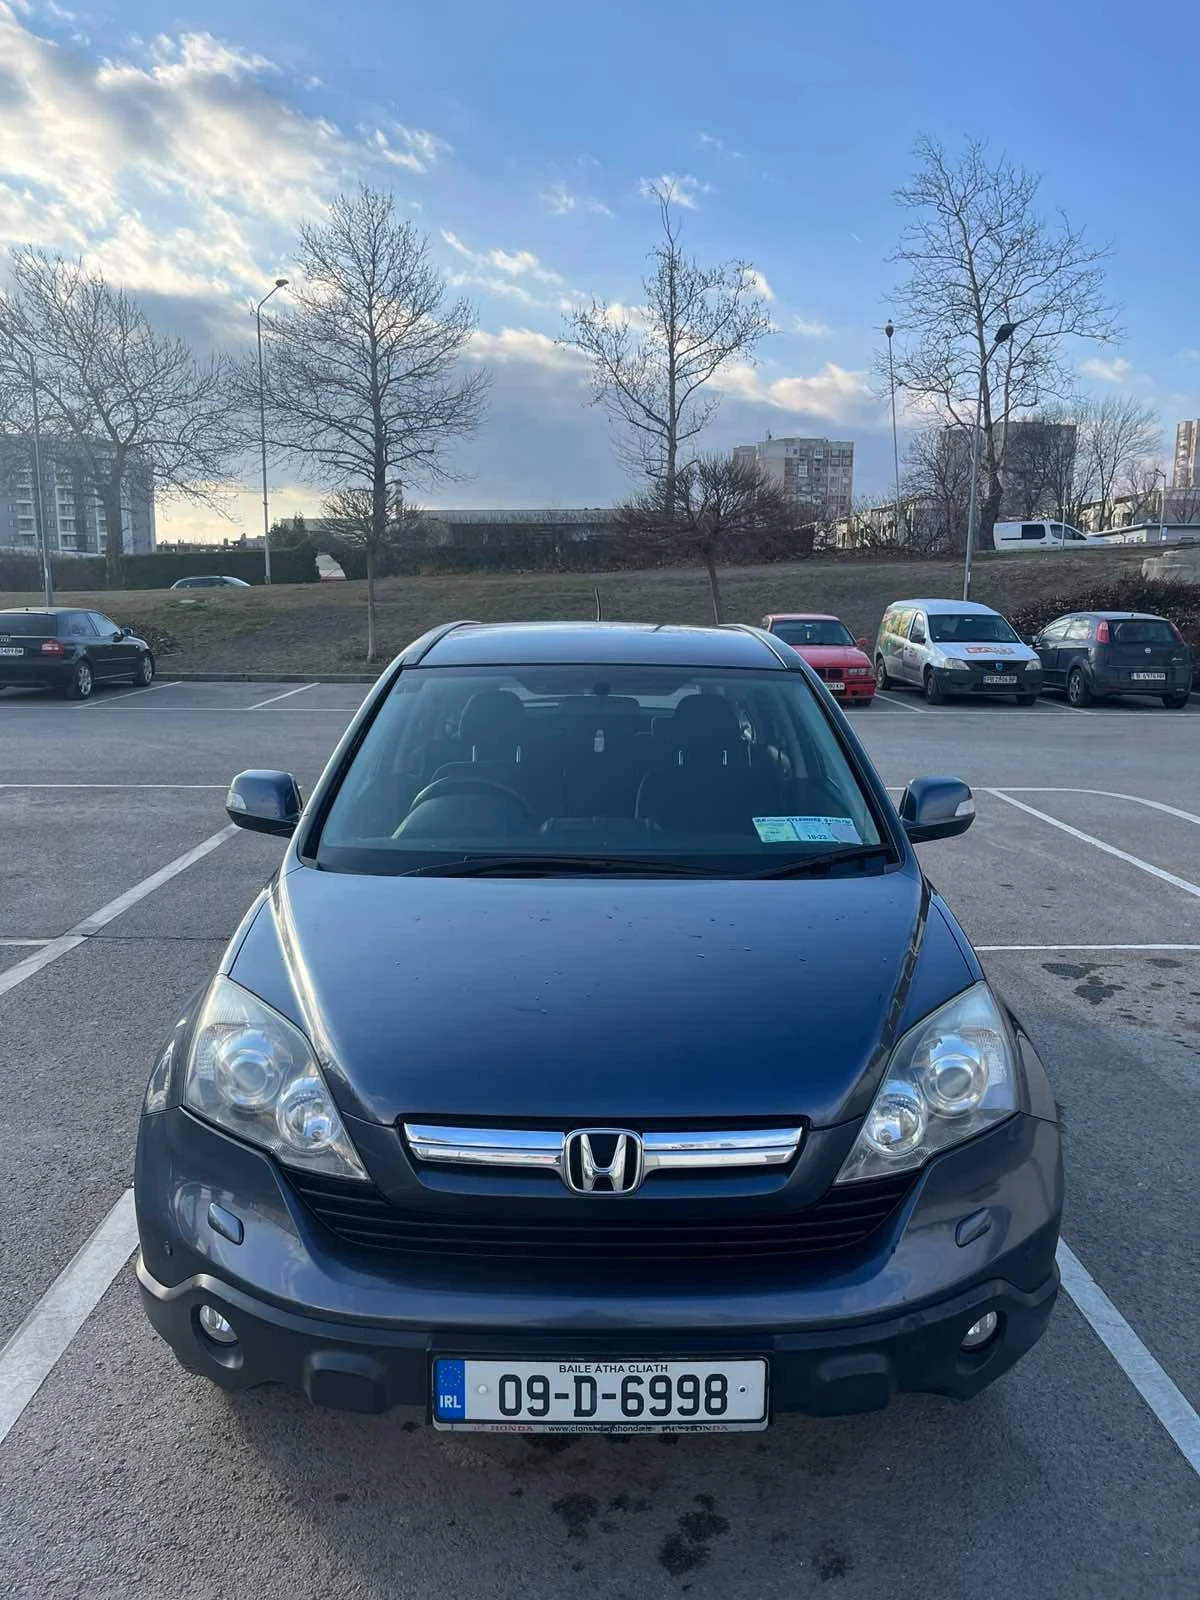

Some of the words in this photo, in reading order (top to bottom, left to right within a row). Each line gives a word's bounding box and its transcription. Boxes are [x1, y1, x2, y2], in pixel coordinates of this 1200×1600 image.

[559, 1364, 591, 1373] BAILE
[595, 1363, 625, 1373] ÁTHA
[628, 1364, 668, 1373] CLIATH
[439, 1395, 462, 1409] IRL
[498, 1373, 728, 1417] 09-D-6998
